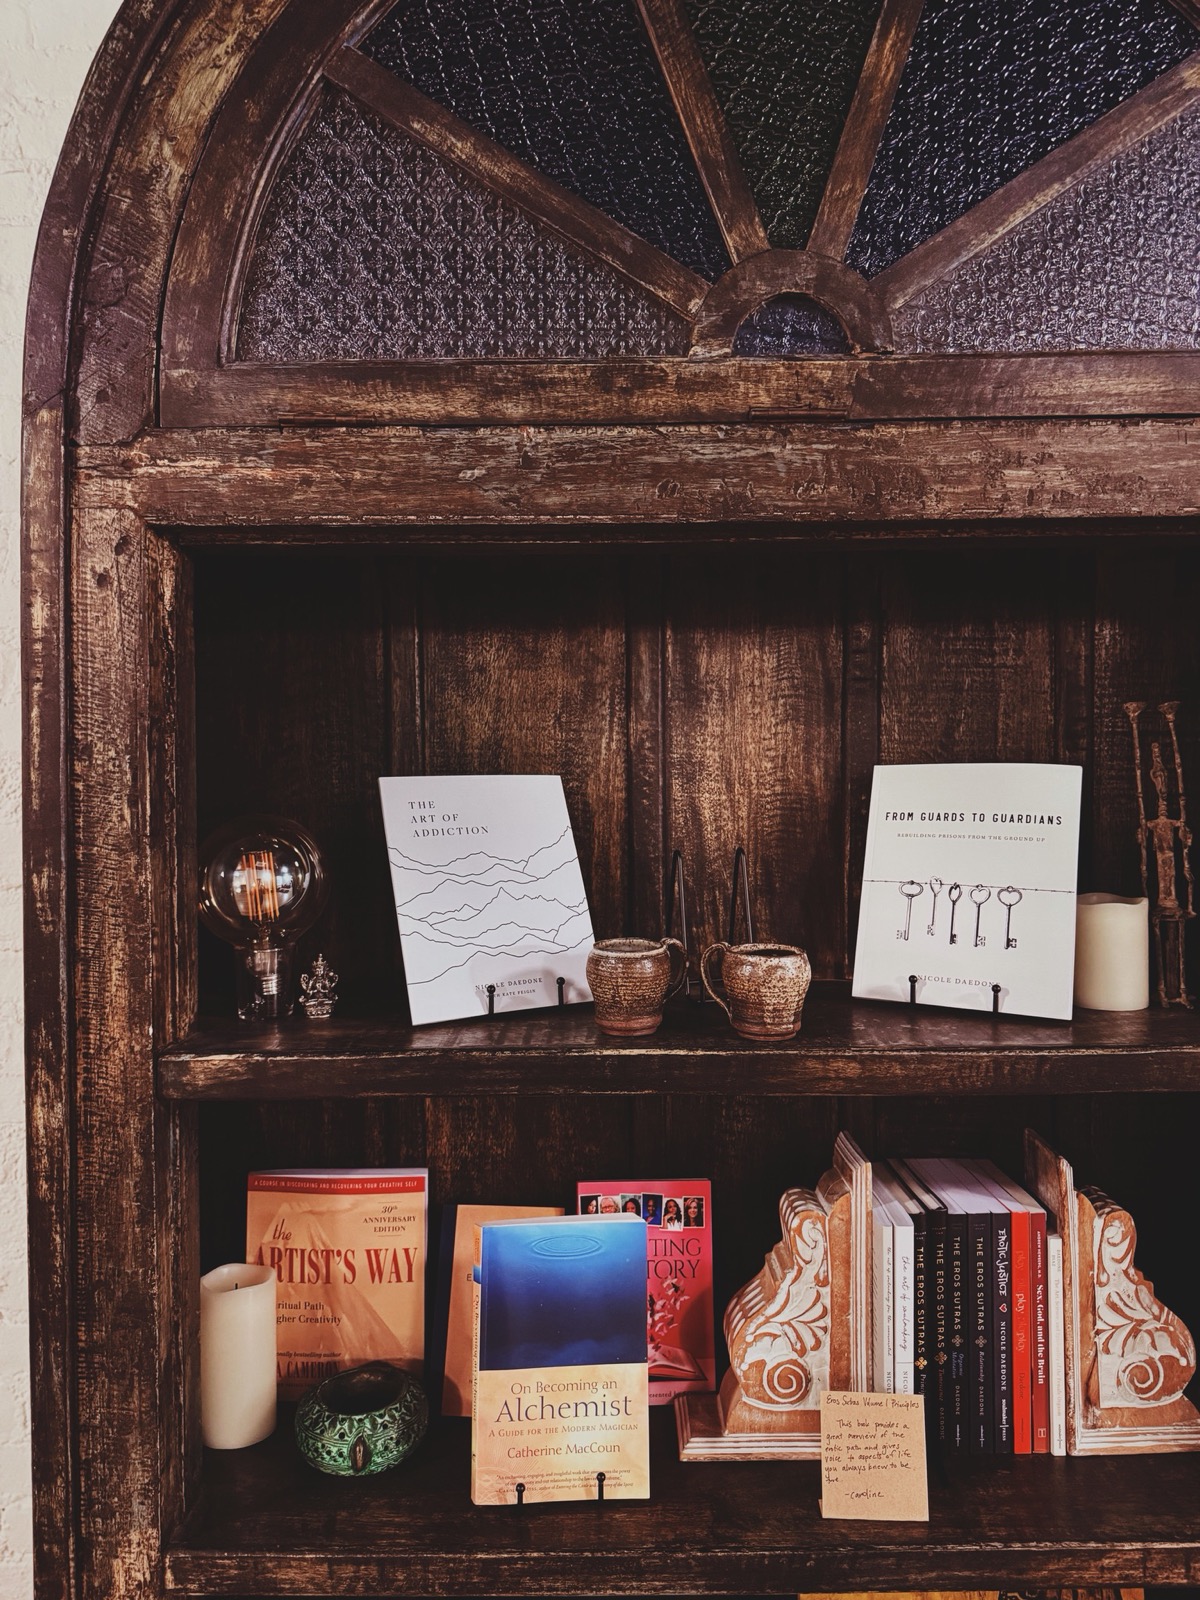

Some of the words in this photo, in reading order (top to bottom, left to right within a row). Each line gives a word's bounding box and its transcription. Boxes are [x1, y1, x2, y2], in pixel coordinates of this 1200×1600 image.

[408, 801, 435, 809] THE
[411, 814, 436, 823] ART
[442, 814, 458, 822] OF
[885, 812, 914, 821] FROM
[920, 812, 965, 822] GUARDS
[972, 813, 986, 822] TO
[992, 813, 1062, 825] GUARDIANS
[413, 826, 488, 837] ADDICTION
[475, 982, 504, 991] NICLE
[508, 978, 543, 986] DAEDONE
[917, 974, 951, 983] NICOLE
[382, 1205, 398, 1213] 30th
[273, 1219, 292, 1241] the
[648, 1238, 701, 1256] TING
[936, 1243, 944, 1264] THE
[976, 1237, 984, 1256] THE
[364, 1247, 418, 1284] WAY
[646, 1259, 700, 1280] TORY
[902, 1256, 910, 1271] the
[902, 1276, 910, 1291] art
[917, 1275, 925, 1305] EROS
[900, 1293, 910, 1301] of
[1036, 1284, 1044, 1303] Sex,
[277, 1301, 301, 1310] ritual
[304, 1302, 324, 1310] Path
[1016, 1293, 1026, 1313] play
[977, 1292, 985, 1331] SUTRAS
[298, 1315, 342, 1326] Creativity
[899, 1305, 911, 1351] soulmaking
[917, 1310, 925, 1353] SUTRAS
[511, 1383, 531, 1395] On
[536, 1379, 598, 1393] Becoming
[602, 1380, 618, 1389] an
[494, 1394, 632, 1422] Alchemist
[827, 1395, 840, 1405] Eros
[842, 1395, 860, 1406] Sutras
[863, 1397, 883, 1407] Volume
[891, 1399, 919, 1411] Principles
[836, 1419, 852, 1428] This
[857, 1419, 870, 1427] book
[826, 1433, 842, 1445] great
[881, 1430, 888, 1438] of
[892, 1430, 905, 1438] the
[507, 1446, 562, 1458] Catherine
[565, 1442, 620, 1455] MacCoun
[825, 1444, 842, 1452] erotic
[846, 1444, 861, 1453] path
[882, 1443, 900, 1455] gives
[825, 1455, 841, 1463] voice
[848, 1454, 854, 1462] to
[858, 1452, 882, 1462] aspects
[886, 1450, 896, 1459] of
[898, 1449, 911, 1458] life
[825, 1466, 837, 1478] you
[842, 1464, 866, 1474] always
